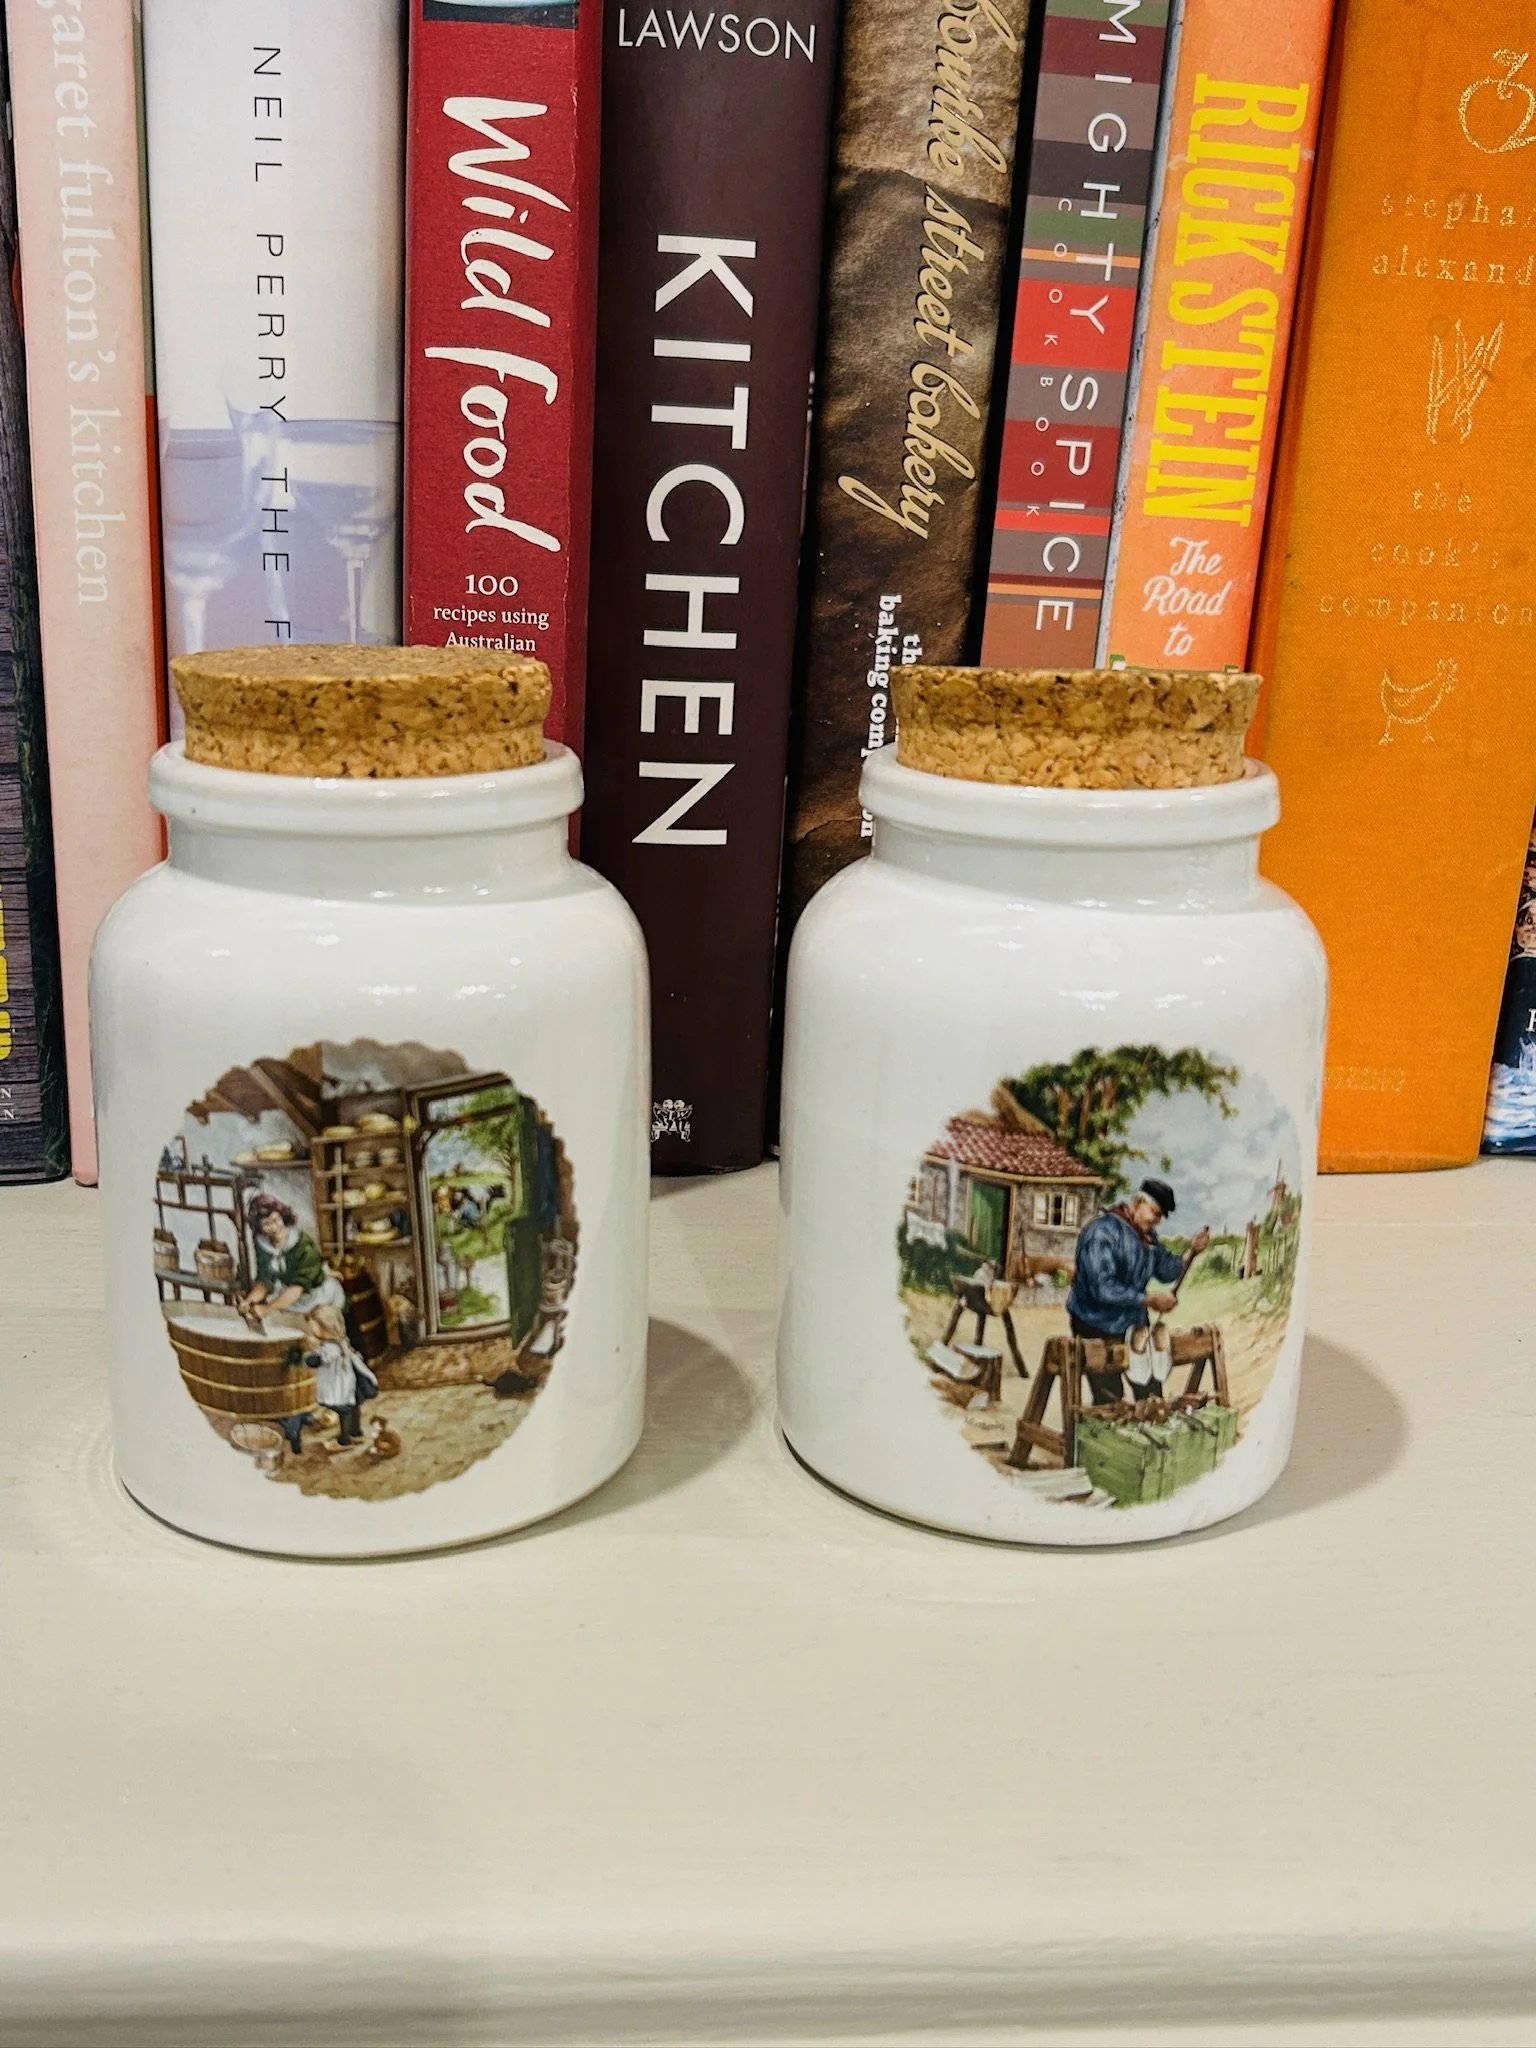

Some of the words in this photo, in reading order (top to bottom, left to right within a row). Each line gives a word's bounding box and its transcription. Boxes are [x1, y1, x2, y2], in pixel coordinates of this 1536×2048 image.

[252, 46, 283, 183] NEIL
[617, 7, 817, 64] LAWSON
[442, 96, 572, 329] Wild
[1069, 0, 1142, 336] MIGHTY
[1173, 72, 1310, 276] RICK
[58, 156, 117, 384] fulton's
[255, 232, 288, 423] PERRY
[913, 180, 985, 358] street
[837, 360, 982, 541] bakery
[1142, 280, 1280, 528] STEIN
[69, 404, 127, 606] kitchen
[259, 466, 291, 573] THE
[464, 573, 520, 597] 100
[631, 233, 757, 846] KITCHEN
[1034, 372, 1100, 632] SPICE
[1168, 535, 1224, 577] The
[433, 604, 497, 628] recipes
[501, 607, 551, 631] using
[866, 594, 903, 690] baking
[902, 633, 923, 665] th
[1141, 574, 1233, 617] Road
[1162, 620, 1196, 658] to
